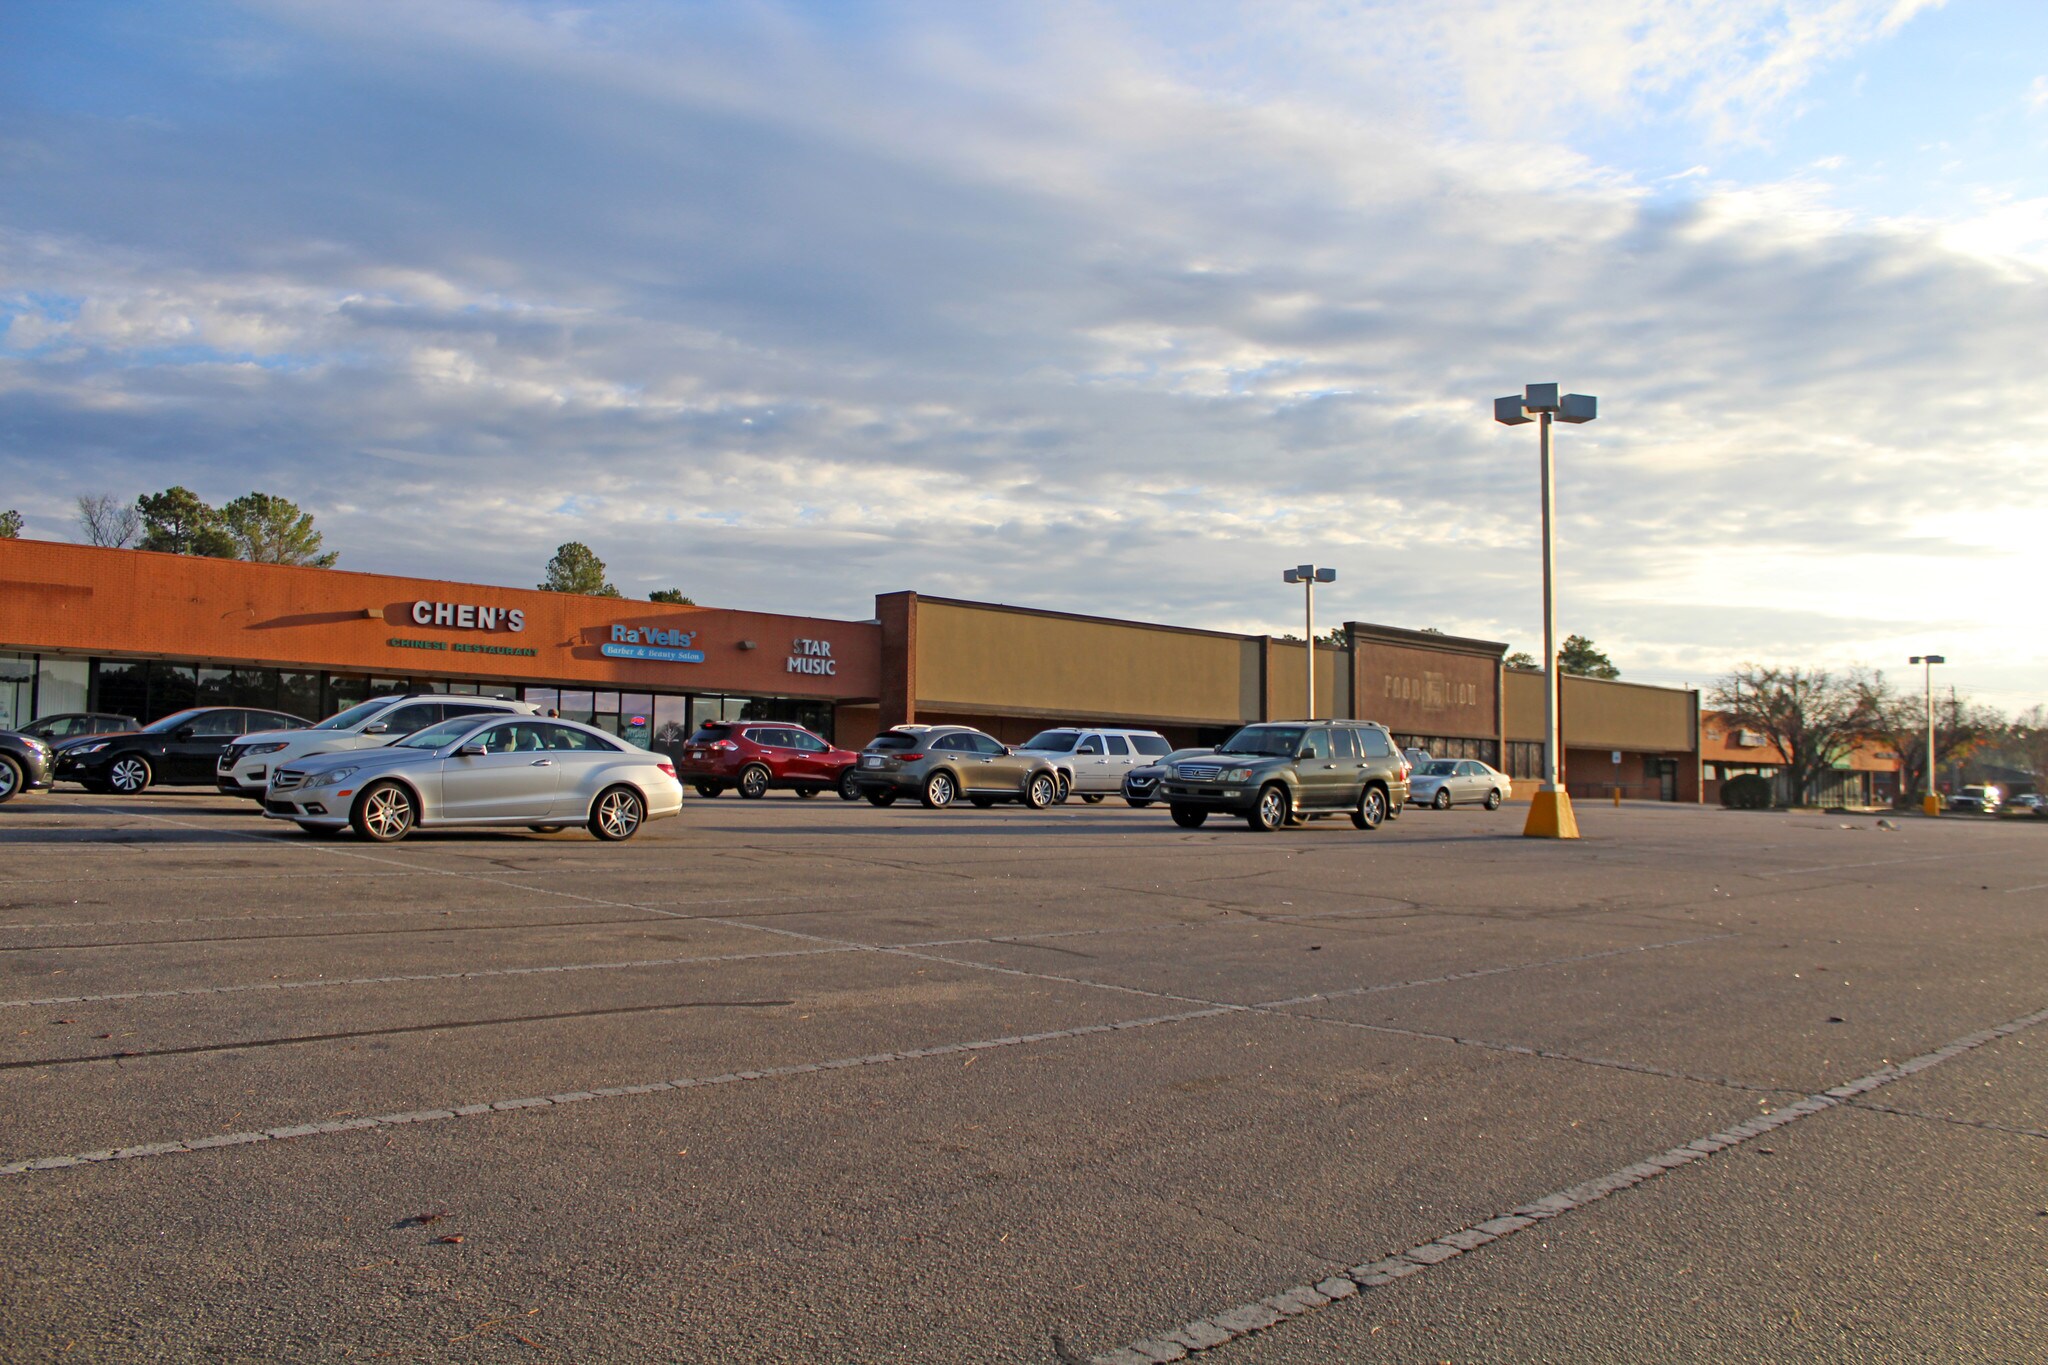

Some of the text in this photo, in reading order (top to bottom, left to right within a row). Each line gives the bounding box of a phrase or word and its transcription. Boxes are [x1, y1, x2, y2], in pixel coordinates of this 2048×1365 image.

[412, 600, 525, 632] CHEN'S
[391, 638, 538, 657] CHINESE RESTAURANT
[607, 646, 700, 660] Barber & Beauty Salon
[793, 639, 831, 657] STAR
[787, 657, 836, 675] MUSIC
[1385, 675, 1420, 700] FOOD
